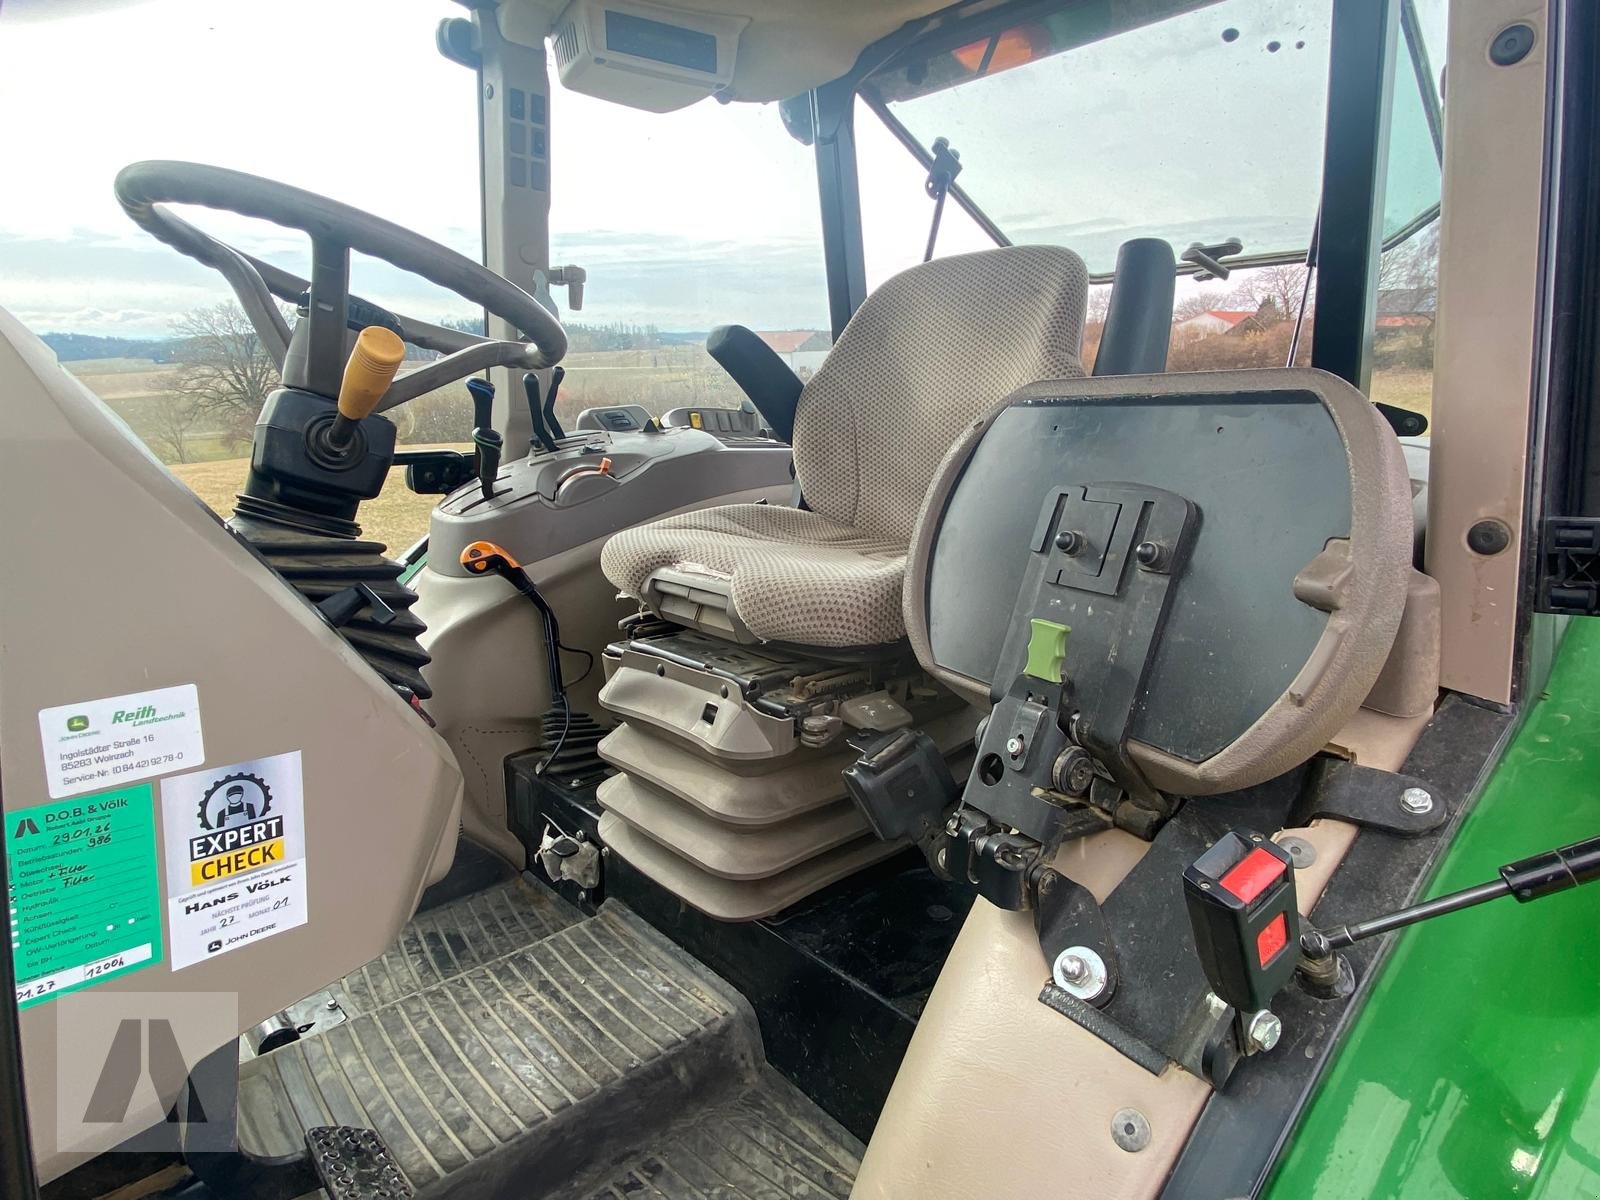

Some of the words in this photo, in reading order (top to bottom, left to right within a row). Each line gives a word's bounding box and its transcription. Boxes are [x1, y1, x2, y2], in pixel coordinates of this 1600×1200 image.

[112, 705, 156, 724] Reith
[133, 712, 186, 726] Landtechnik
[60, 744, 111, 761] Ingolstädter
[114, 738, 140, 750] Straße
[143, 735, 154, 743] 16
[61, 759, 92, 771] 85283
[95, 750, 134, 766] Wolnzach
[45, 808, 85, 823] D.O.B.
[88, 804, 97, 814] &
[99, 798, 128, 812] Völk
[88, 834, 111, 848] 986
[192, 819, 280, 859] EXPERT
[201, 844, 276, 880] CHECK
[185, 893, 239, 915] HANS
[246, 875, 292, 894] VÖLK
[273, 897, 288, 910] 01
[212, 904, 240, 919] NÄCHSTE
[241, 895, 270, 909] PRÜFUNG
[249, 907, 270, 918] MONAT
[201, 925, 217, 936] JAHR
[220, 916, 235, 928] 27
[225, 933, 248, 945] JOHN
[250, 923, 276, 936] DEERE
